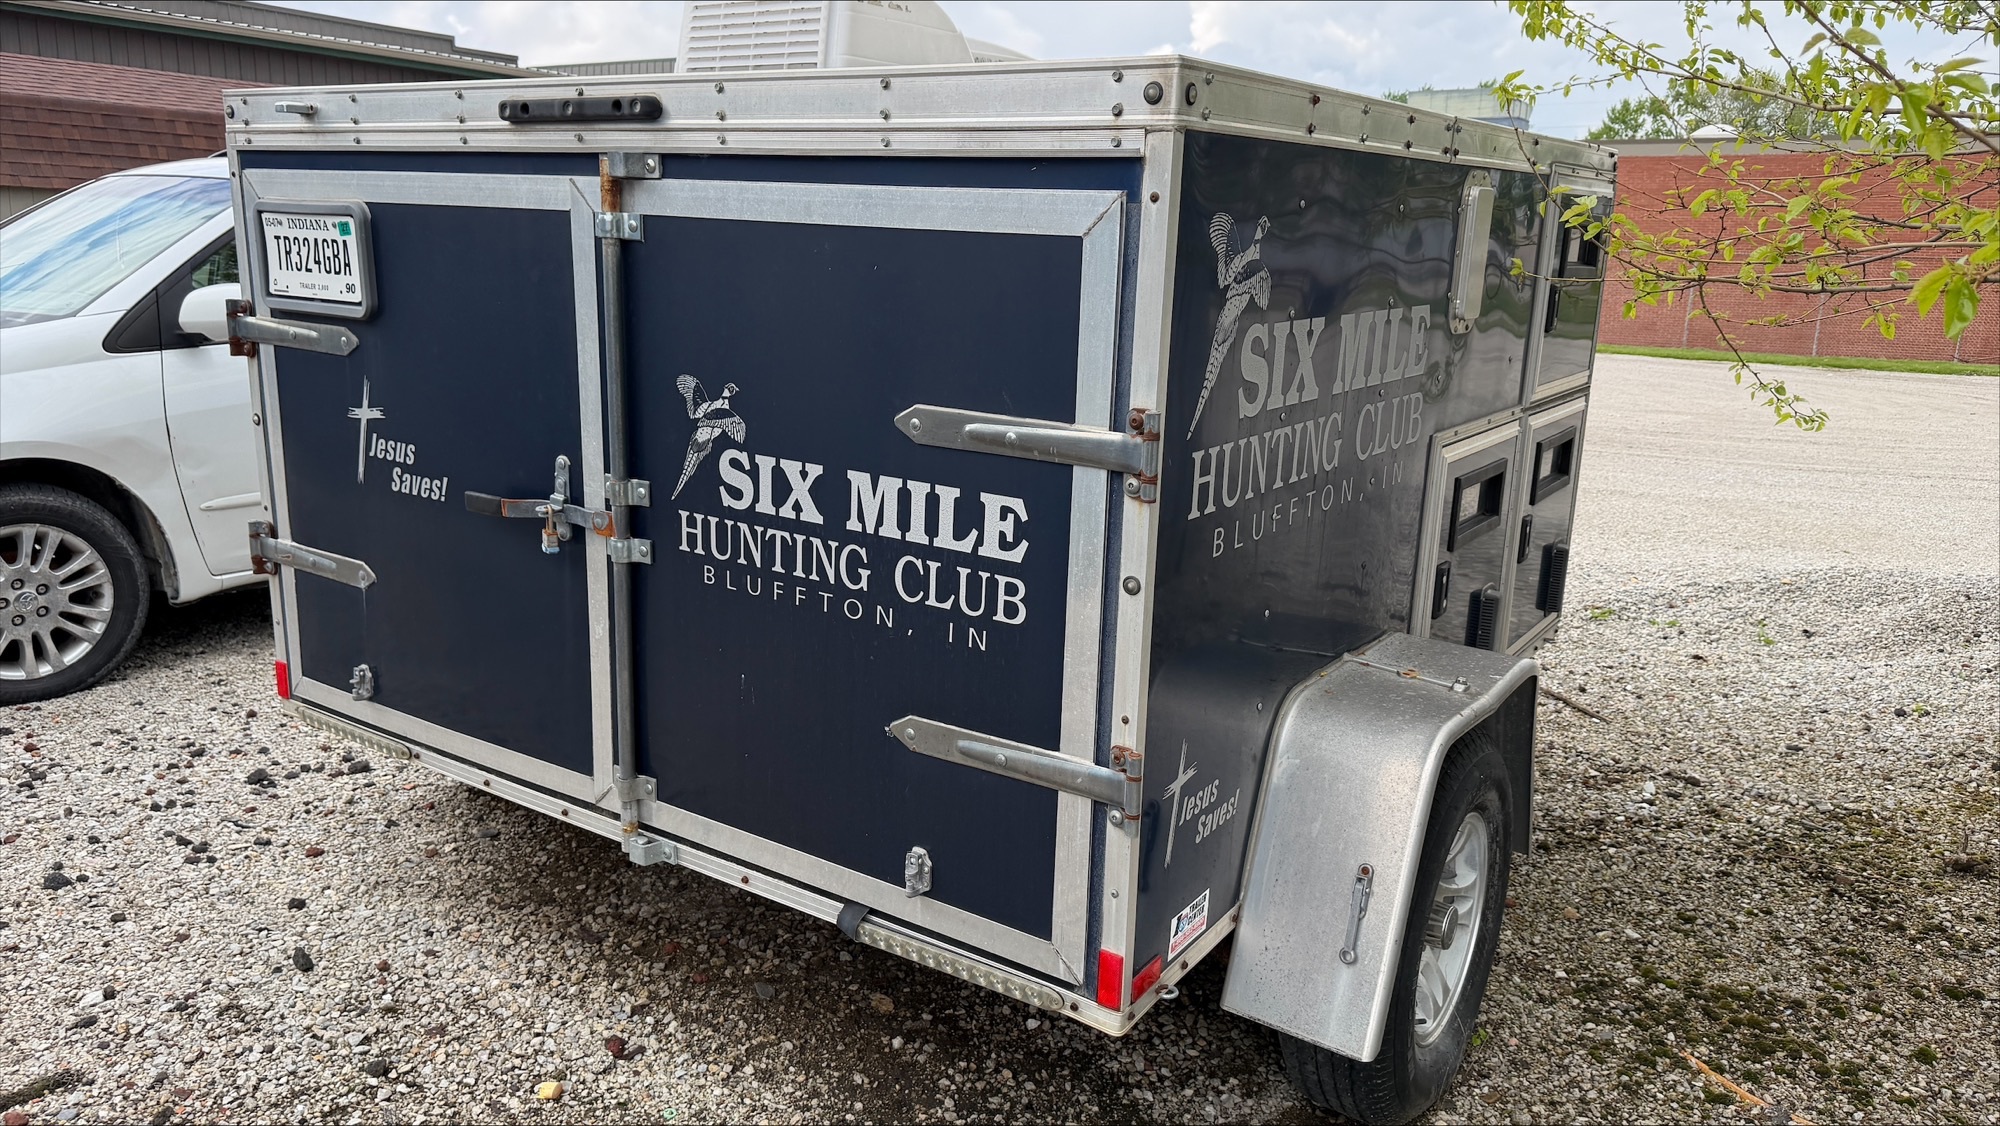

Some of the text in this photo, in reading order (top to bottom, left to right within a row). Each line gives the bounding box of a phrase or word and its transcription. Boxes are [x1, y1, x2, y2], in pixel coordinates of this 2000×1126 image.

[286, 217, 330, 231] INDIANA
[274, 235, 352, 276] TR324GBA
[299, 282, 317, 290] TRAILER
[345, 283, 356, 294] 90
[1238, 304, 1431, 419] SIX MILE
[369, 433, 416, 465] Jesus
[1187, 392, 1424, 520] HUNTING CLUB
[391, 466, 448, 502] Saves!
[718, 448, 1030, 564] SIX MILE
[1212, 460, 1403, 558] BLUFFTON, IN
[678, 509, 1027, 625] HUNTING CLUB
[703, 565, 988, 651] BLUFFTON, IN
[1179, 779, 1219, 826] Jesus
[1195, 788, 1240, 844] Saves!
